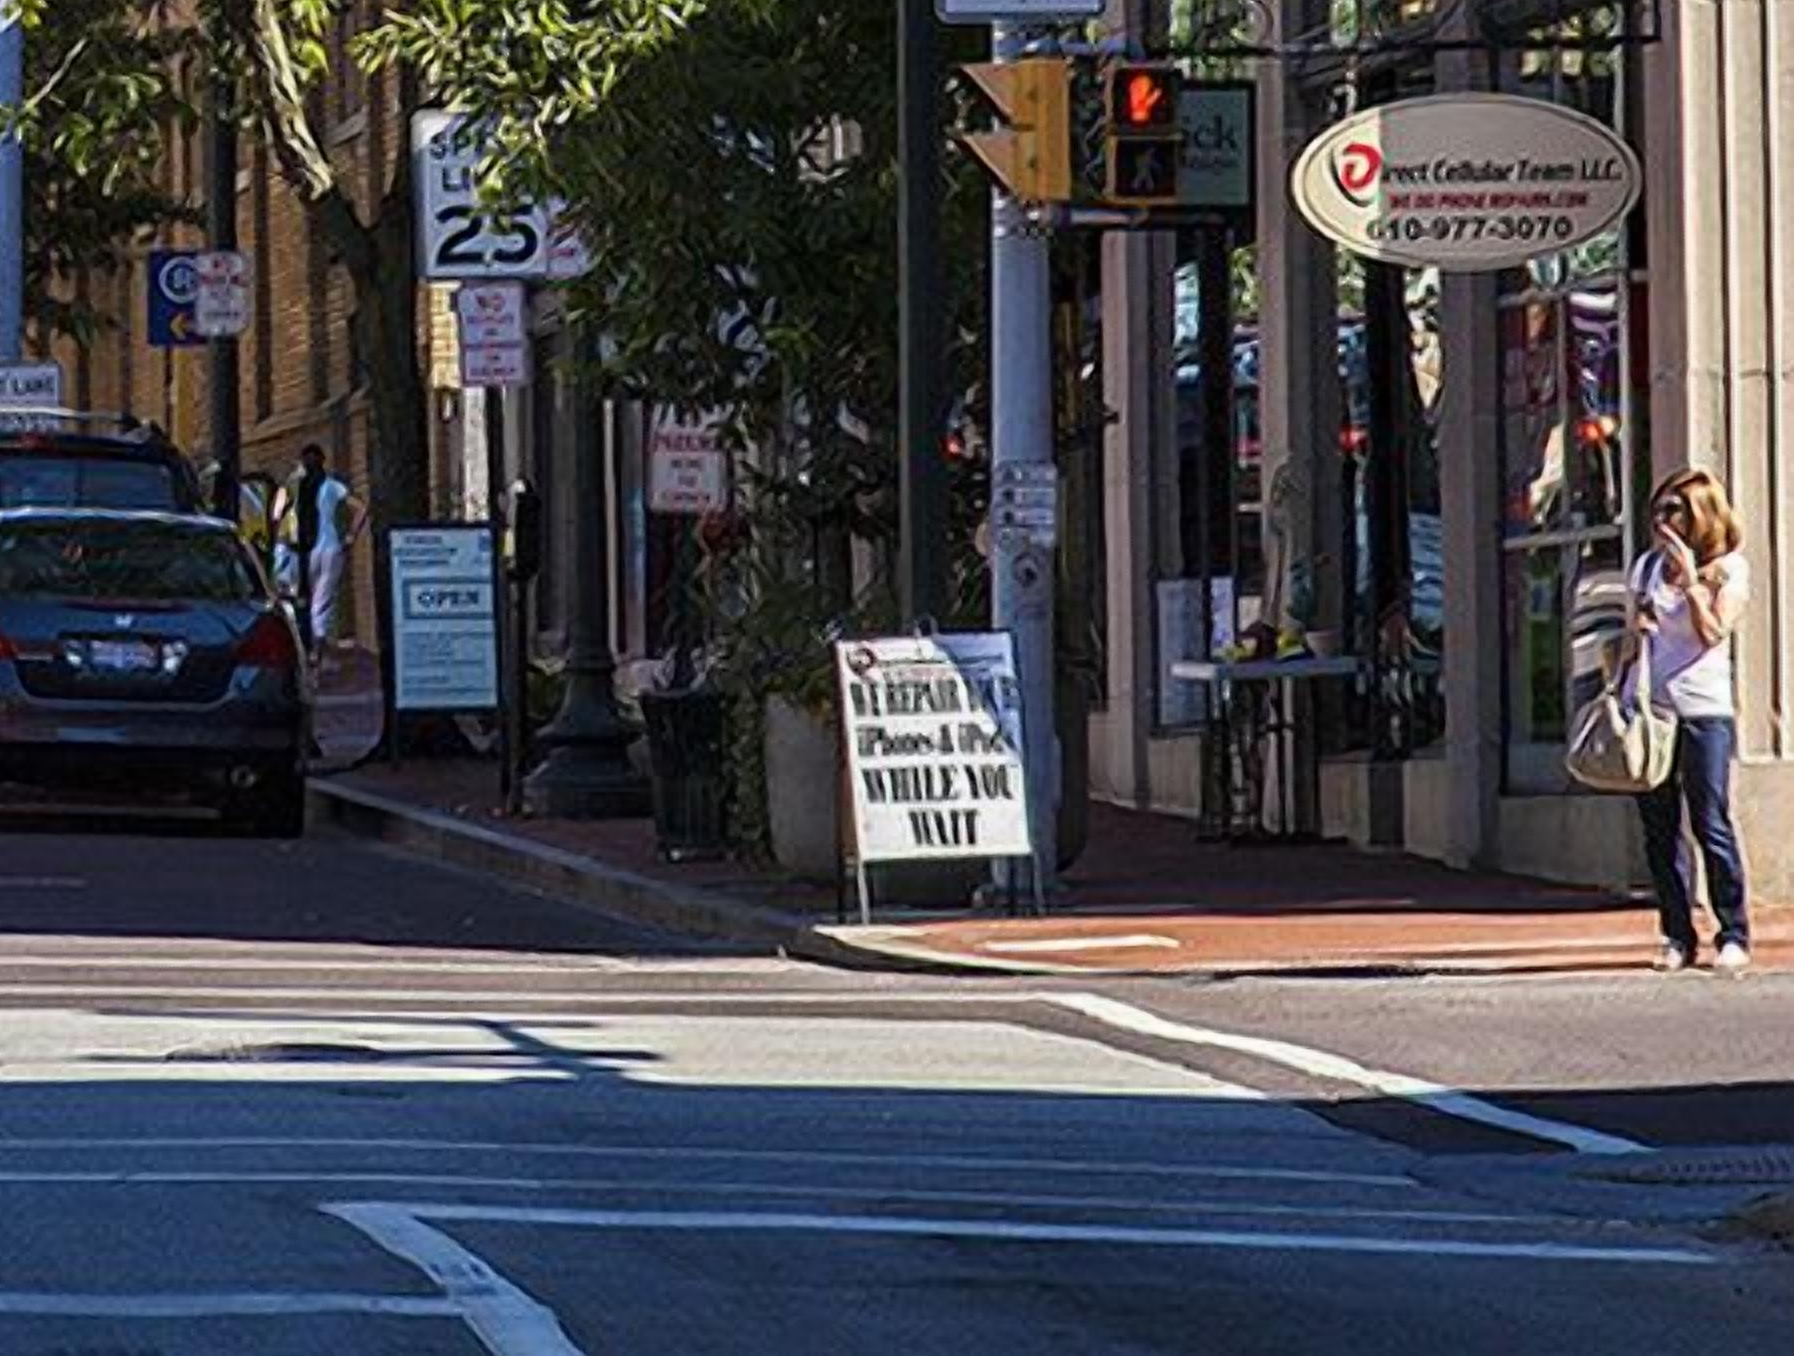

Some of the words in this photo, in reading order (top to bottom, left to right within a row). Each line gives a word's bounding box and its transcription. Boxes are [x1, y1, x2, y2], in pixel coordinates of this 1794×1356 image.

[1515, 157, 1575, 181] Team
[436, 204, 539, 265] 25
[418, 591, 479, 607] OPEN
[861, 763, 961, 804] WHILE
[964, 763, 1015, 802] YOU
[908, 808, 983, 847] WAIT
